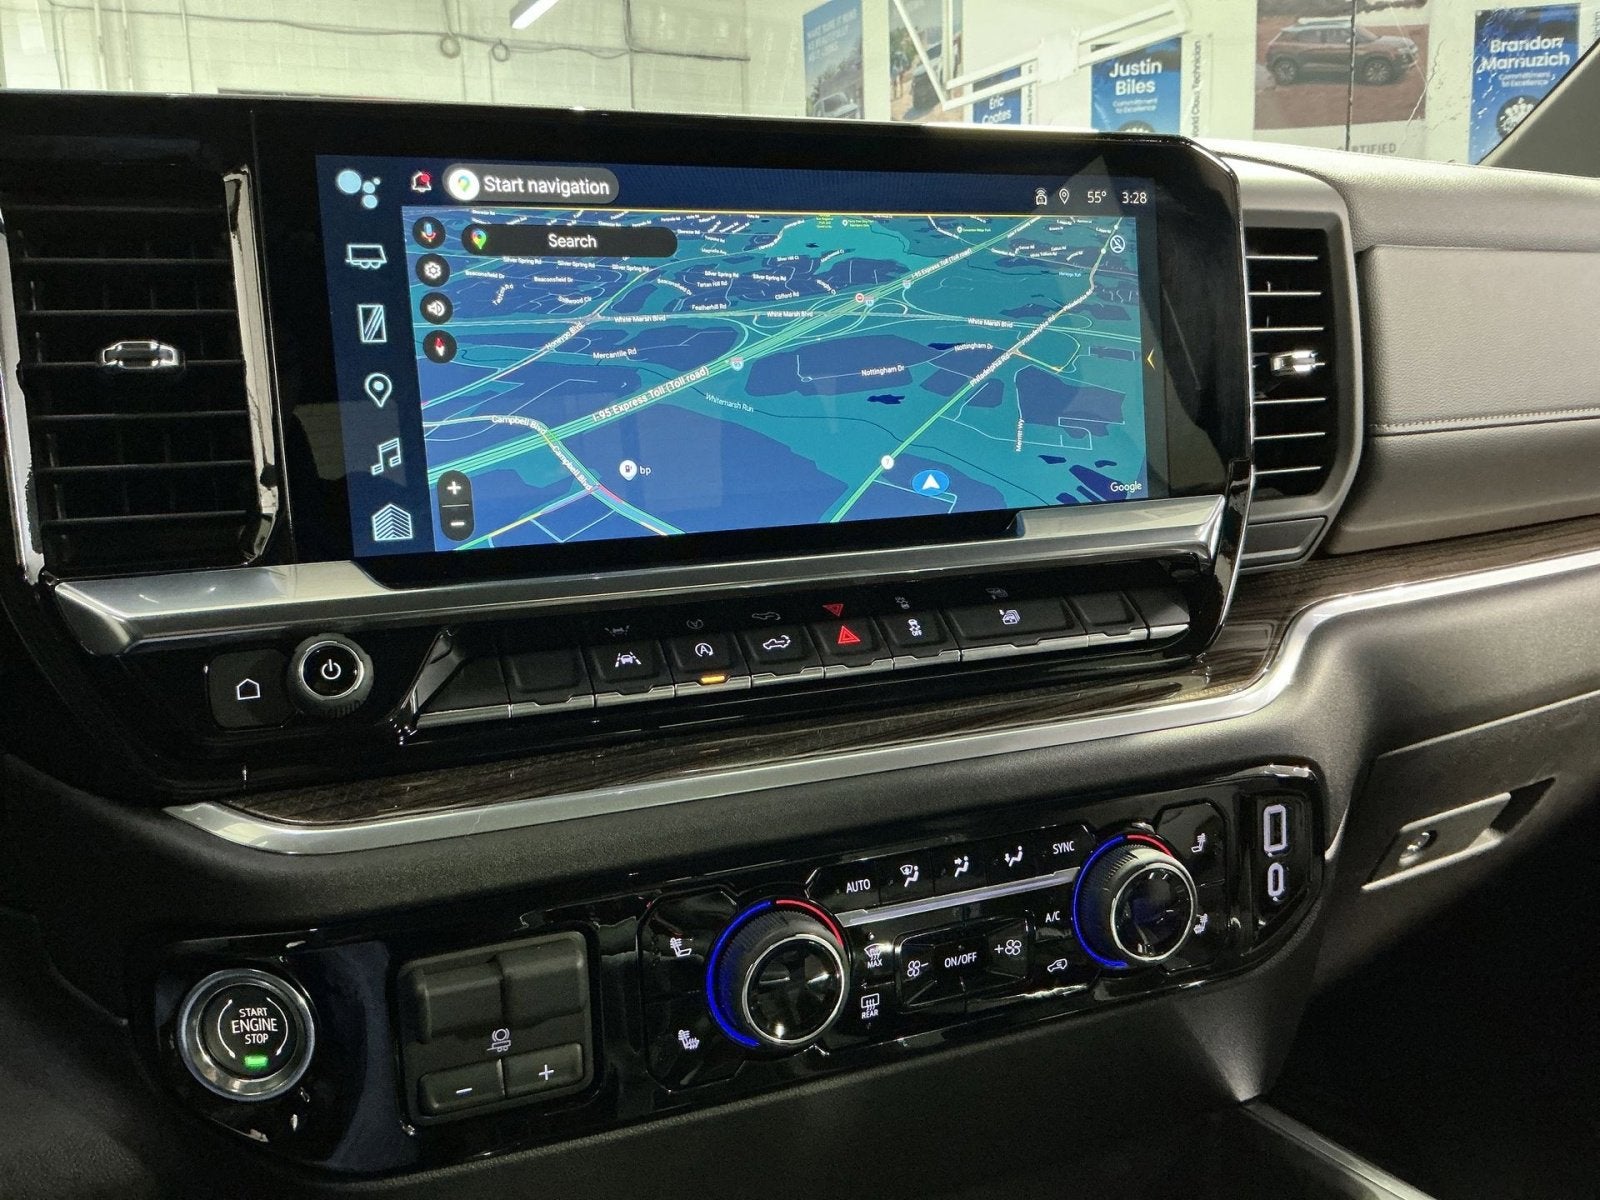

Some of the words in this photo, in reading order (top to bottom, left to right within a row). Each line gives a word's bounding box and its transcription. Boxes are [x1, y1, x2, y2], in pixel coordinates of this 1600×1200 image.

[1489, 36, 1564, 54] Brandon
[1109, 58, 1162, 78] Justin
[1192, 41, 1201, 89] Technician
[1115, 78, 1156, 96] Biles
[989, 95, 1005, 110] Eric
[484, 176, 525, 193] Start
[528, 178, 610, 198] navigation
[1087, 190, 1107, 204] 55°
[1121, 191, 1148, 204] 3:28
[548, 233, 598, 248] Search
[968, 317, 983, 325] White
[983, 319, 1000, 327] Marsh
[1000, 320, 1014, 328] Blvd
[1021, 321, 1049, 346] Philadelphia
[592, 350, 627, 359] Mercantile
[627, 347, 637, 356] Rd
[954, 342, 986, 352] Nottingham
[861, 367, 897, 376] Nottingham
[969, 357, 1003, 387] Philadelphia
[1001, 352, 1011, 363] Rd
[592, 406, 612, 422] I-95
[612, 393, 648, 415] Express
[648, 386, 665, 400] Toll
[665, 377, 686, 392] (Toll
[685, 365, 710, 383] road)
[742, 403, 754, 413] Run
[491, 415, 529, 425] Campbell
[529, 421, 546, 435] Blvd
[552, 445, 580, 477] Campbell
[577, 474, 592, 491] Blvd
[639, 465, 651, 477] bp
[1110, 481, 1142, 493] Google
[1052, 840, 1075, 855] SYNC
[846, 879, 871, 893] AUTO
[1045, 910, 1061, 923] A/C
[867, 958, 883, 969] MAX
[944, 952, 977, 968] ON/OFF
[239, 1007, 267, 1018] START
[861, 1009, 879, 1019] REAR
[232, 1018, 278, 1034] ENGINE
[245, 1034, 268, 1045] STOP
